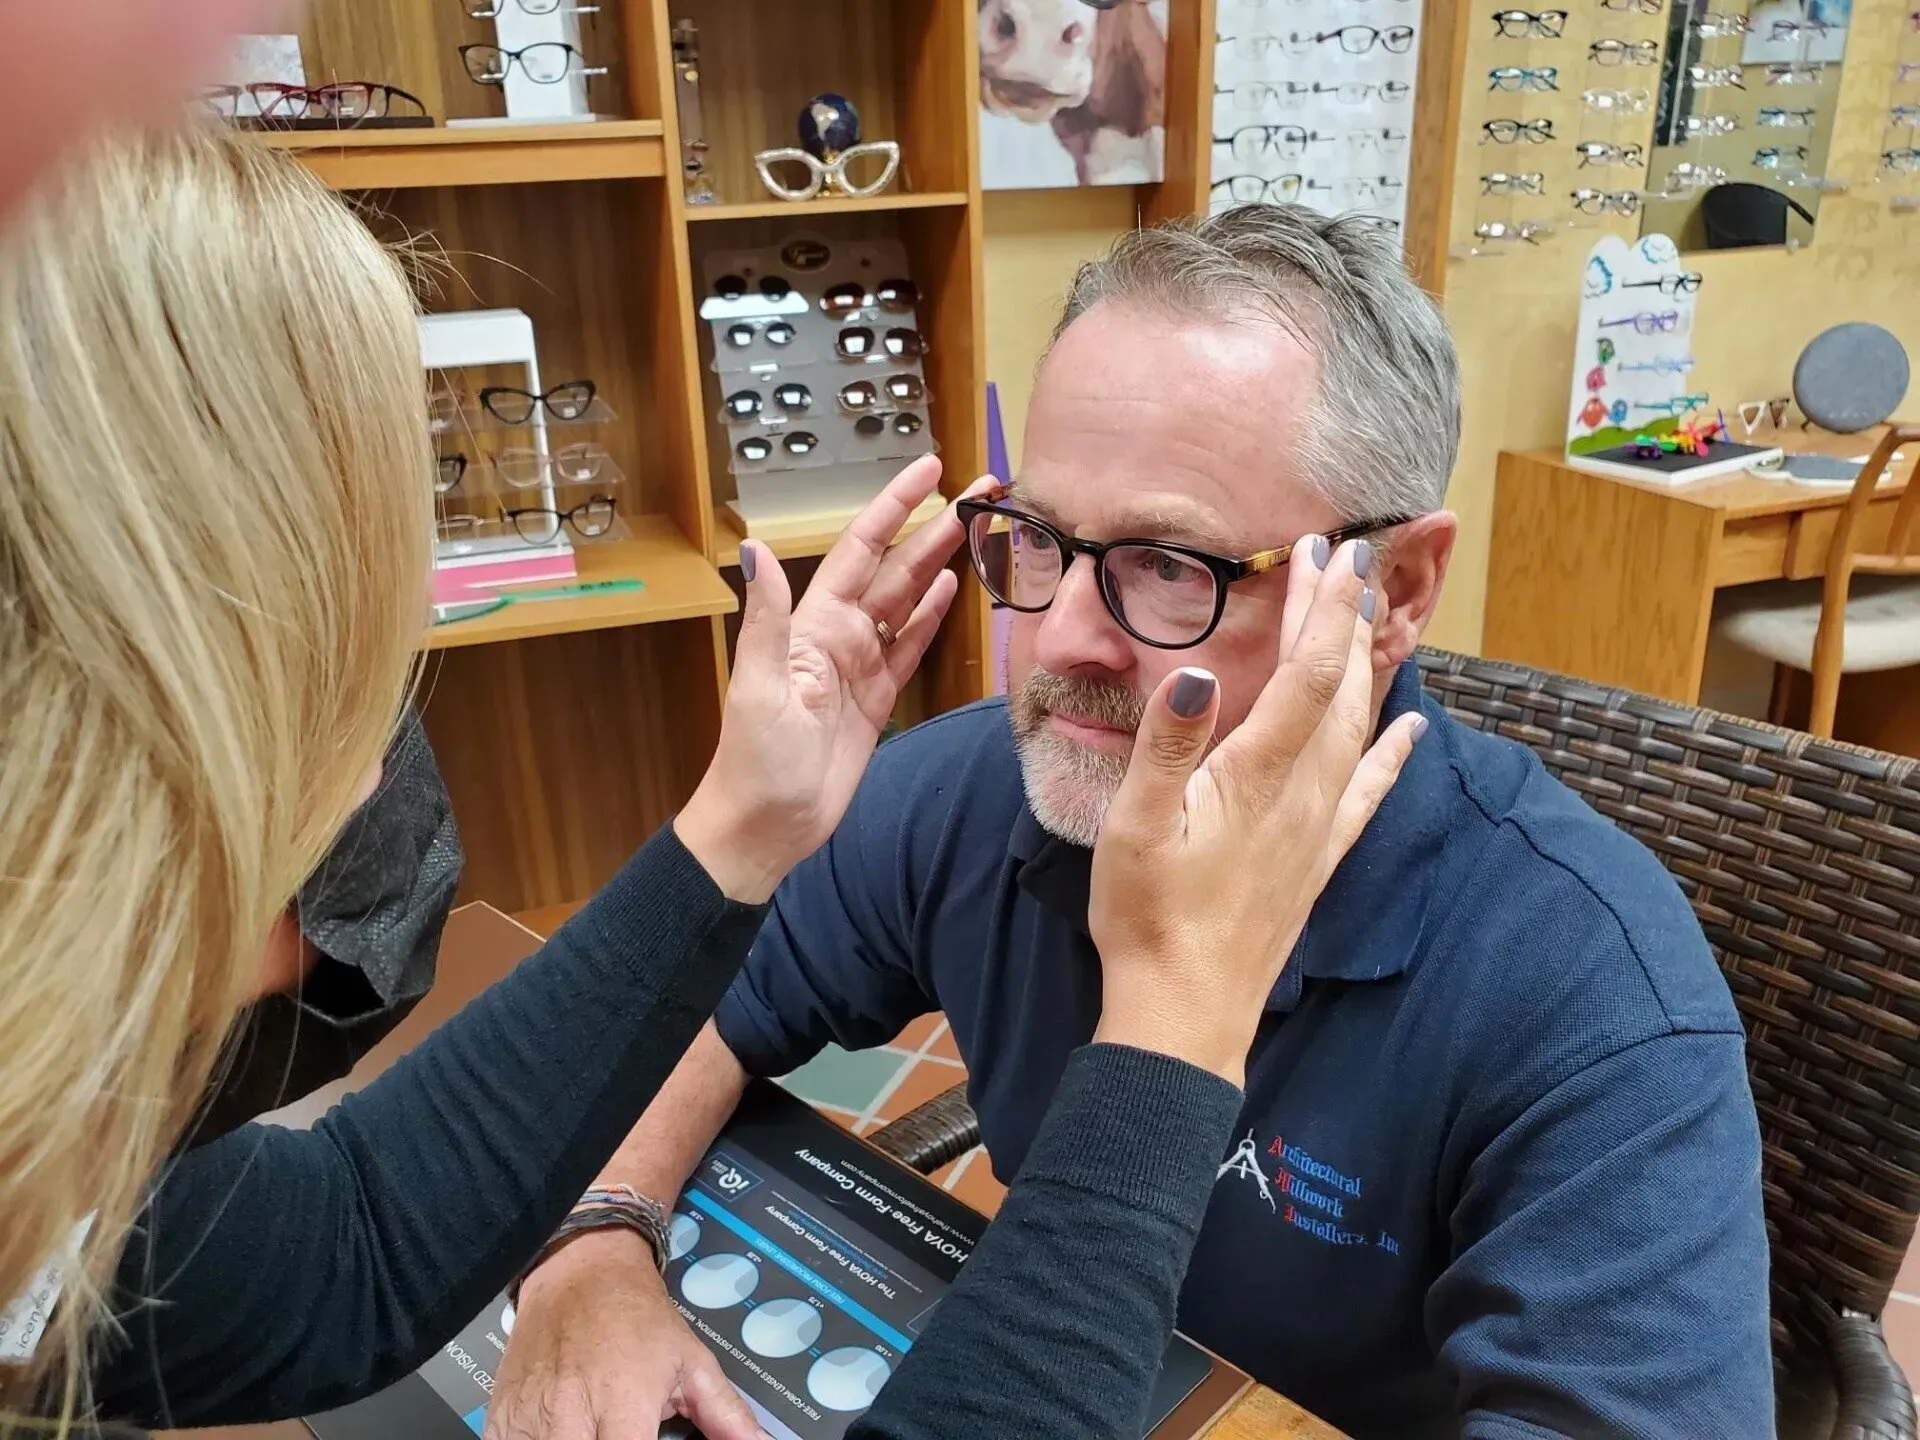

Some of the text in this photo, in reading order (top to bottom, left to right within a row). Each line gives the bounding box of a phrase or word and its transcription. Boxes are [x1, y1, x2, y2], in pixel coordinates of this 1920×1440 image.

[718, 1167, 750, 1194] iQ
[795, 1149, 855, 1190] Company
[1275, 1167, 1343, 1218] Millwork
[764, 1205, 806, 1235] Company
[924, 1230, 969, 1263] HOYA
[848, 1262, 879, 1286] HOYA
[877, 1282, 897, 1300] The
[695, 1318, 733, 1351] DISTORTION,
[444, 1340, 478, 1374] VISION
[729, 1347, 747, 1362] LESS
[743, 1358, 764, 1375] HAVE
[760, 1371, 786, 1393] LENSES
[782, 1389, 822, 1421] FREE-FORM
